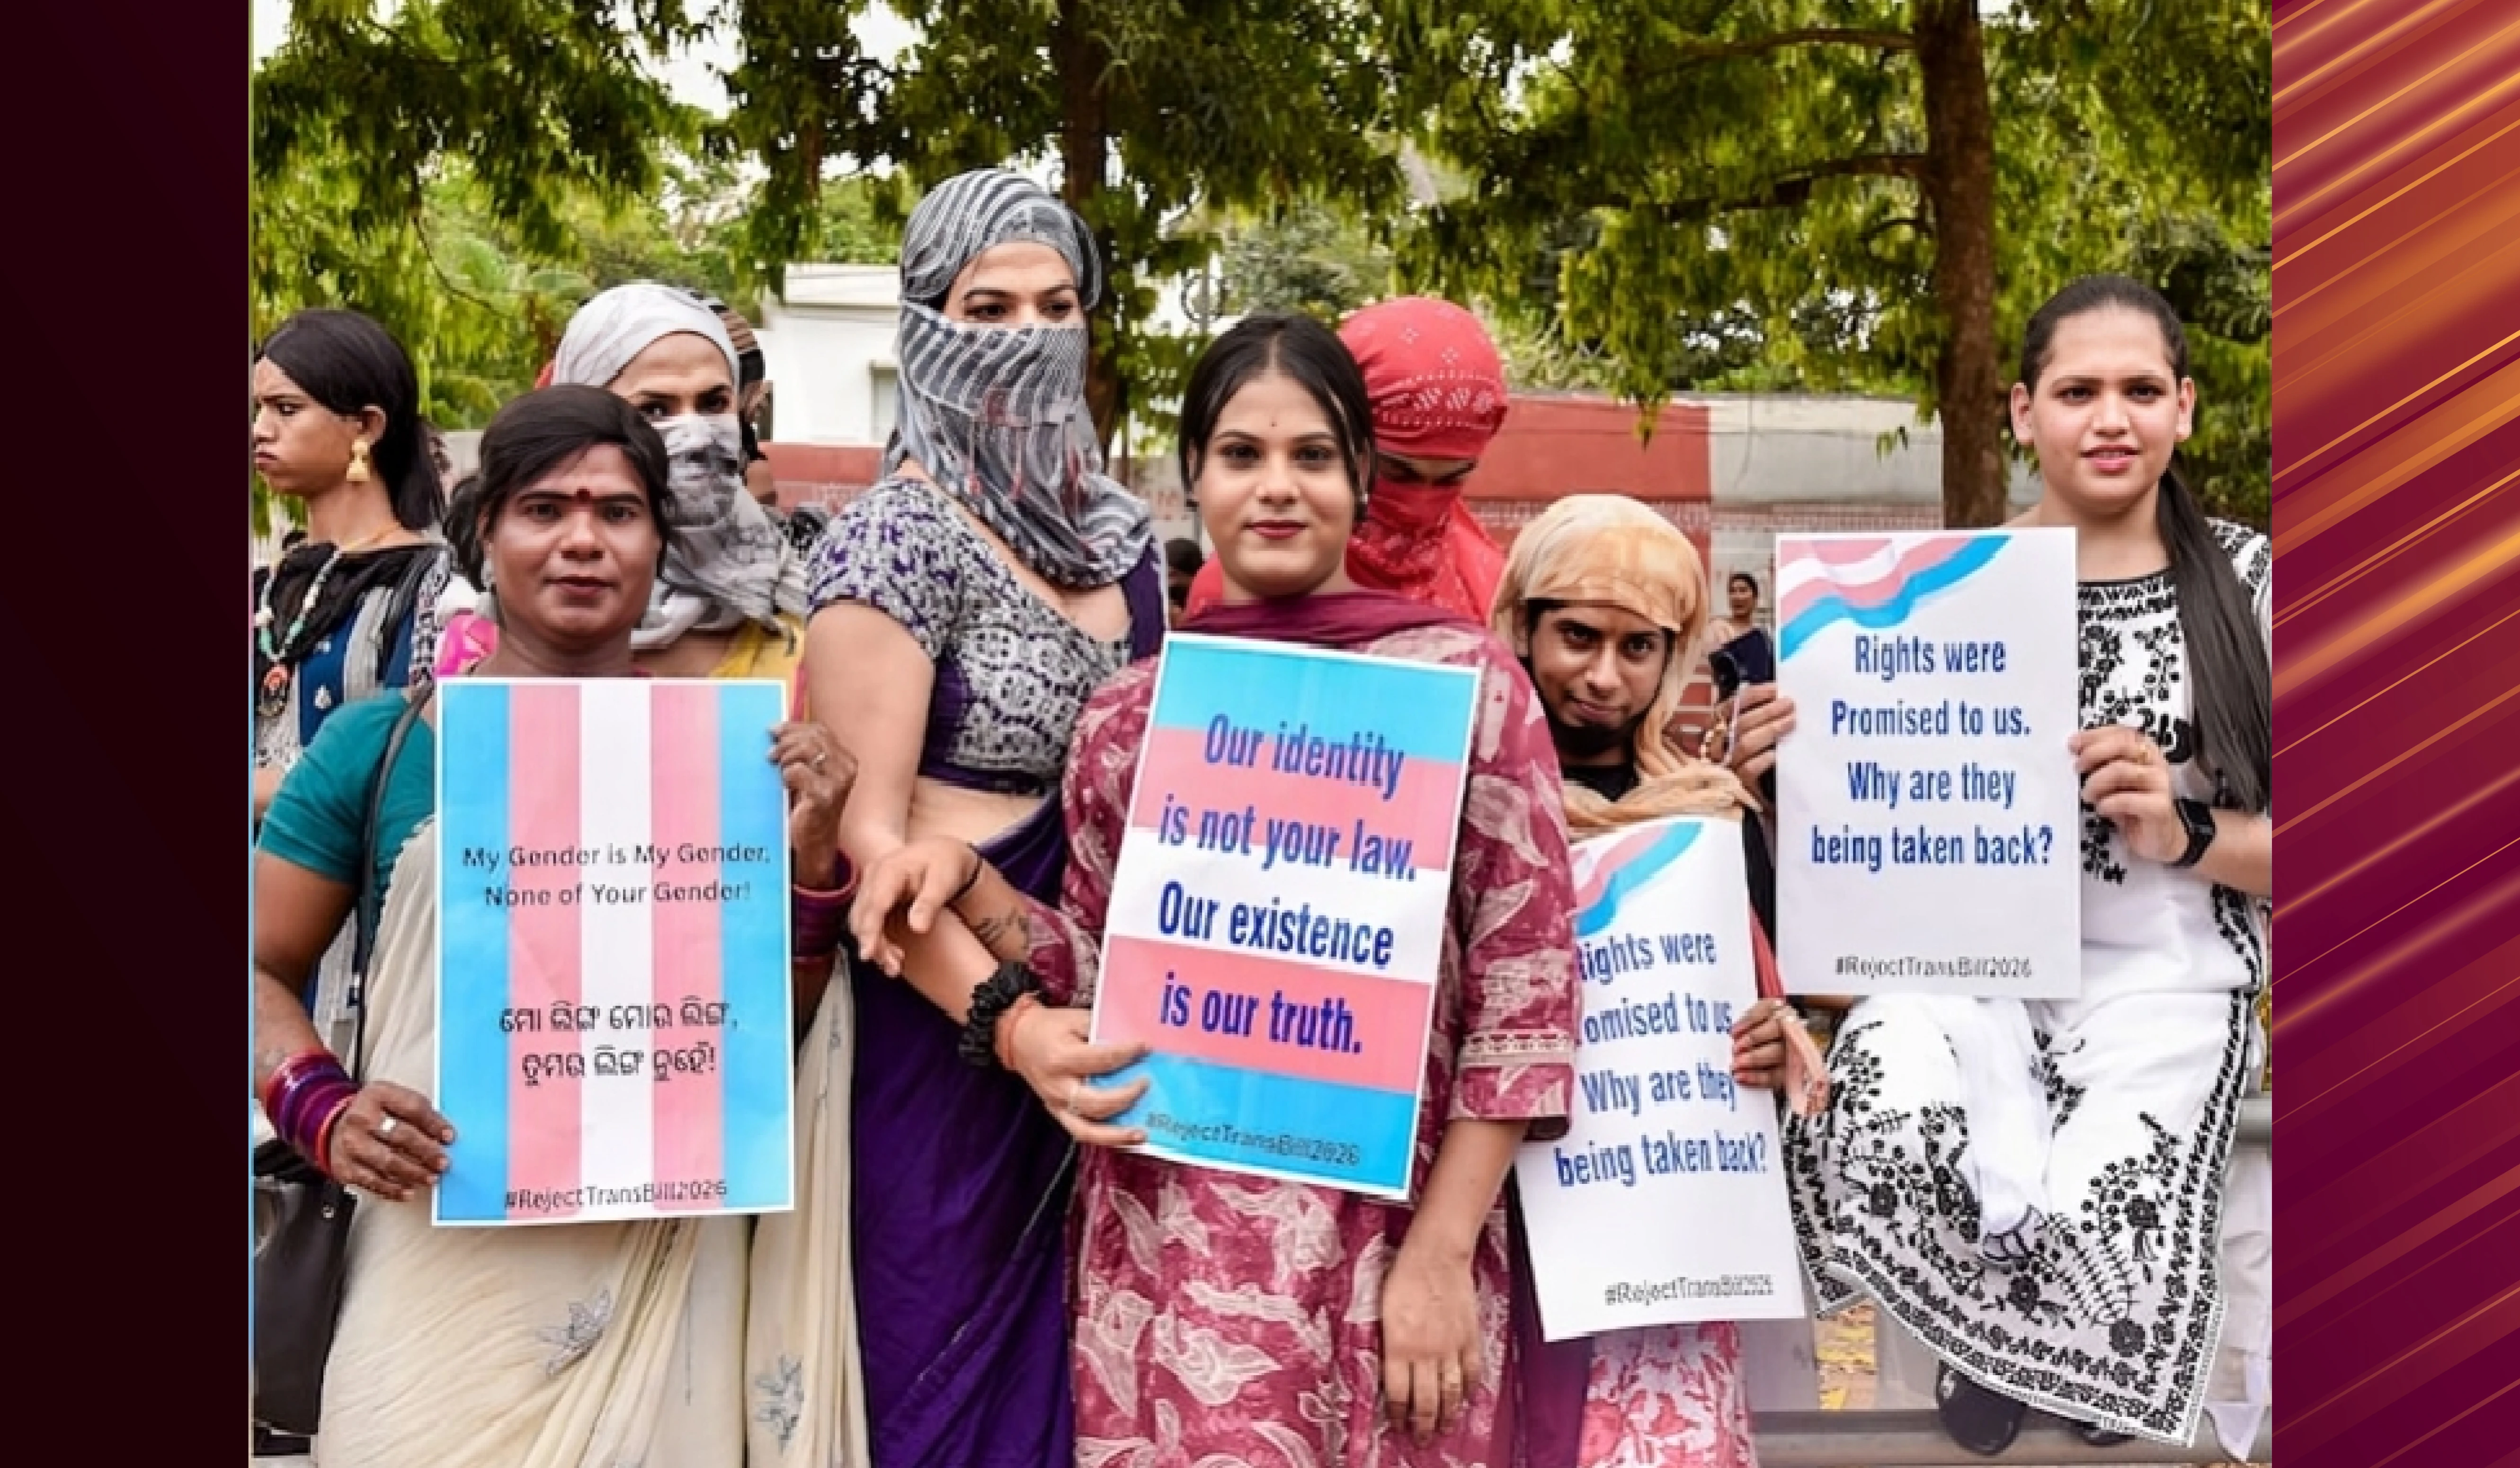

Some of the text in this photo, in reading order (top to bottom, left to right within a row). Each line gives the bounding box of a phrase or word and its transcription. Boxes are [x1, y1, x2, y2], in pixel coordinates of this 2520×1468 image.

[1853, 635, 2007, 682] Rights were
[1831, 699, 2031, 737] Promised to us.
[1204, 714, 1405, 802] Our identity
[1847, 761, 2017, 810] Why are they
[462, 846, 500, 873] My
[509, 845, 600, 867] Gender
[607, 842, 627, 864] is
[634, 843, 670, 869] My
[1158, 793, 1416, 882] is not your law.
[1811, 825, 2054, 872] being taken back?
[485, 879, 751, 907] None of Your Gender!
[1158, 880, 1394, 969] Our existence
[1659, 933, 1717, 965] were
[499, 1006, 541, 1035] ମୋ
[1160, 970, 1362, 1055] is our truth.
[1584, 991, 1680, 1045] omised
[1685, 993, 1710, 1034] to
[1580, 1061, 1737, 1117] Why are they
[1554, 1129, 1768, 1188] being taken back?
[504, 1179, 728, 1213] #RejectTransBill2026
